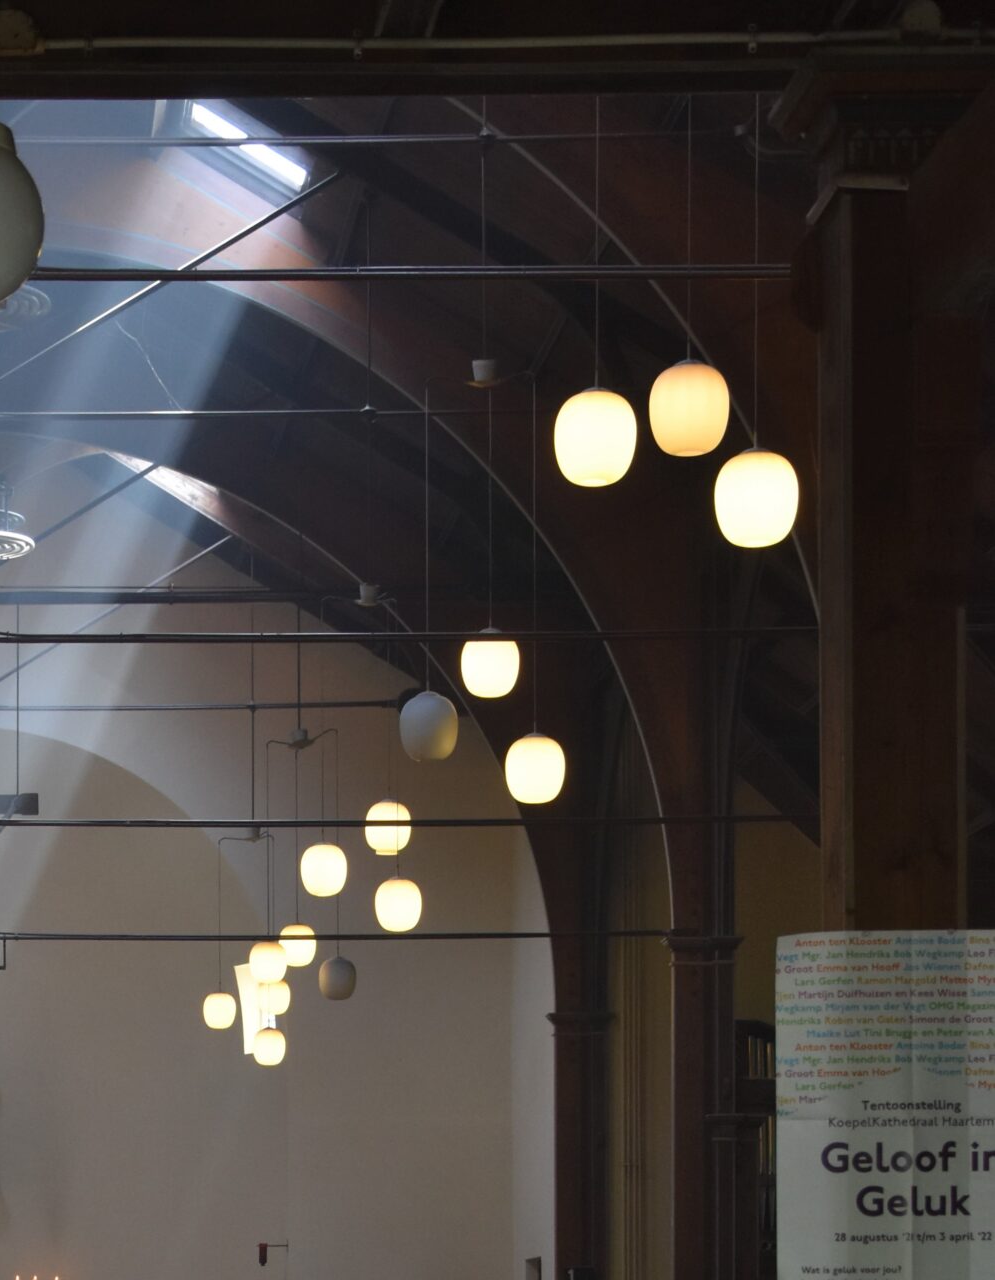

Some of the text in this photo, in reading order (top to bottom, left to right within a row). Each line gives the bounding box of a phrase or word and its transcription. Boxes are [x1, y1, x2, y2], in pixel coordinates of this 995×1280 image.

[795, 939, 826, 947] Anton
[849, 937, 892, 945] Klooster
[826, 951, 843, 959] Jan
[968, 949, 985, 958] Leo
[785, 964, 813, 973] Groot
[817, 964, 848, 972] Emma
[895, 976, 937, 987] Mangold
[798, 991, 835, 1001] Martijn
[910, 990, 934, 998] Kees
[883, 1003, 900, 1011] der
[929, 1002, 955, 1011] OMG
[908, 1015, 946, 1024] Simone
[949, 1015, 961, 1024] de
[964, 1015, 993, 1024] Groot
[795, 1043, 826, 1052] Anton
[829, 1043, 846, 1051] ten
[849, 1042, 893, 1050] Klooster
[826, 1055, 843, 1064] Jan
[968, 1054, 985, 1063] Leo
[785, 1070, 814, 1079] Groot
[817, 1069, 848, 1078] Emma
[862, 1100, 962, 1113] Tentoonstelling
[828, 1116, 995, 1130] KoepelKathedraal Haarlem
[821, 1141, 957, 1173] Geloof
[856, 1185, 971, 1217] Geluk
[834, 1232, 847, 1242] 28
[850, 1233, 899, 1245] augustus
[916, 1232, 936, 1244] t/m
[939, 1232, 946, 1242] 3
[949, 1232, 974, 1244] april
[801, 1265, 902, 1277] Wat is geluk voor jou?
